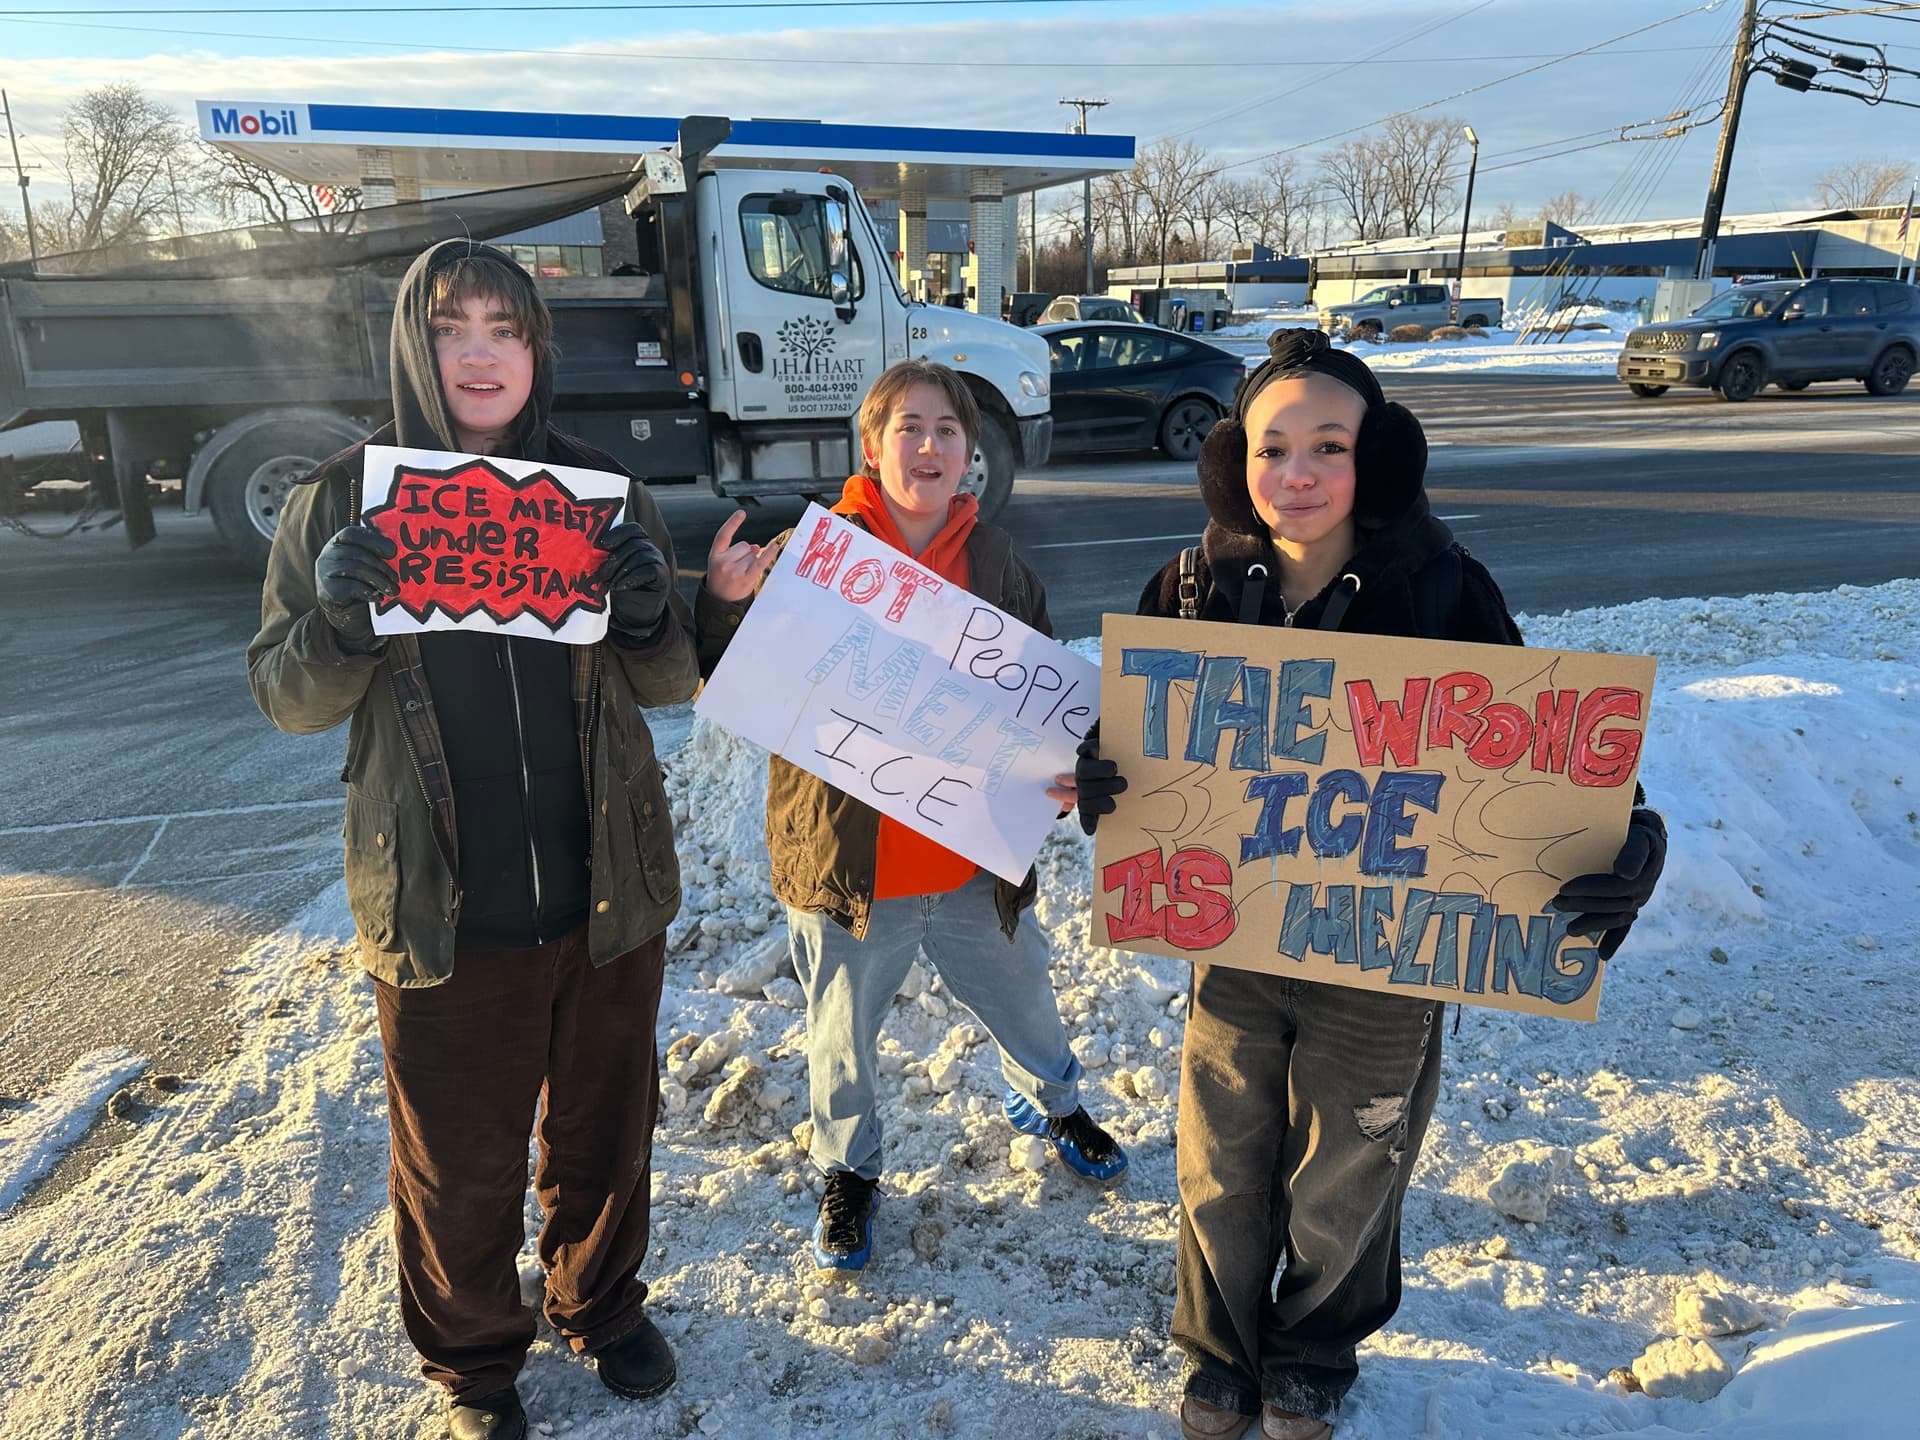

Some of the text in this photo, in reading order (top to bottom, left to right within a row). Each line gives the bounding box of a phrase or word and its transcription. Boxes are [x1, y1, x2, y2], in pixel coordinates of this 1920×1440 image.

[211, 108, 297, 135] Mobil
[912, 328, 927, 339] 28
[772, 357, 864, 379] J.H. HART
[785, 383, 858, 393] 800-404-9390
[788, 403, 851, 413] US DOT 1737621
[400, 483, 491, 518] ICE
[795, 517, 943, 623] HOT
[805, 616, 1045, 798] MELT
[1120, 648, 1644, 787] THE WRONG
[1239, 770, 1446, 878] ICE
[1102, 847, 1601, 1004] IS MELTING
